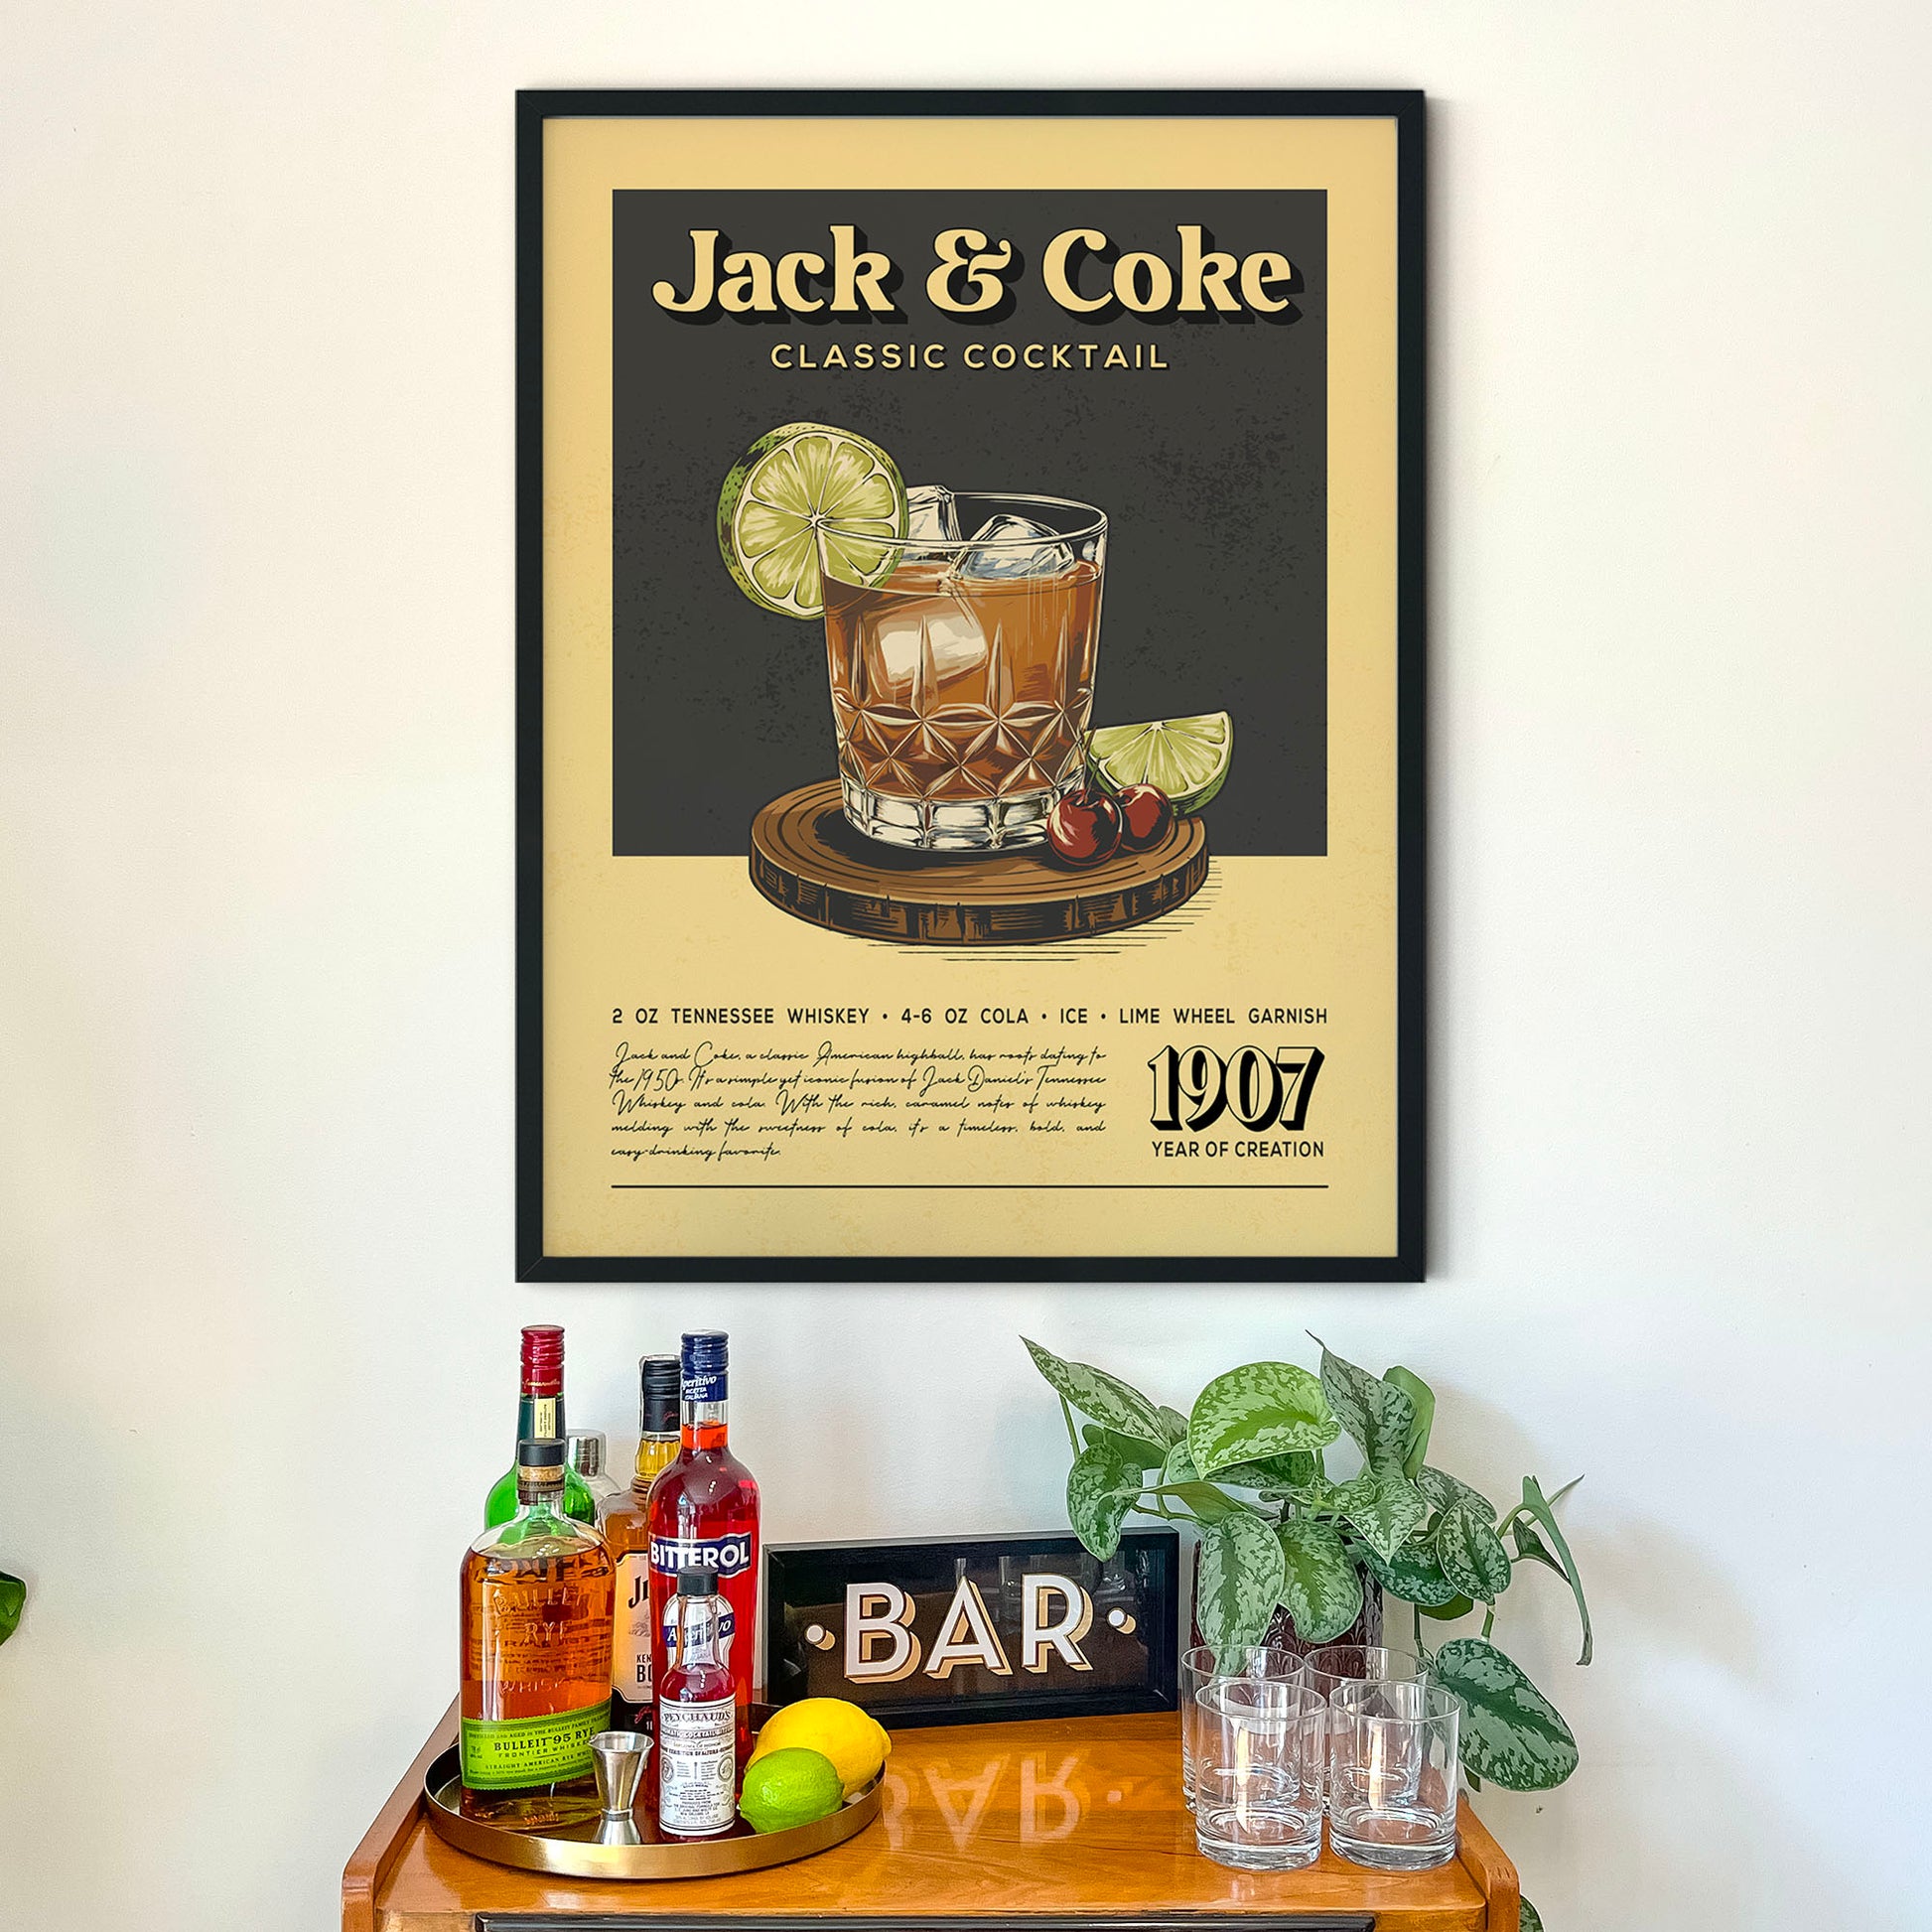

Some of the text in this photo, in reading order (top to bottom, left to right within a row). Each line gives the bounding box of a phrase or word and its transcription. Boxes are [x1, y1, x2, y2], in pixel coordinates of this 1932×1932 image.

[652, 224, 1297, 318] Jack & Coke
[770, 344, 1170, 371] CLASSIC COCKTAIL
[612, 1008, 1328, 1024] 2 OZ TENNESSEE WHISKEY 4-6 OZ COLA ICE LIME WHEEL GARNISH
[613, 1040, 1107, 1072] Jack and Coke, a classic American highball, has roots dating to
[609, 1069, 634, 1089] the
[716, 1075, 729, 1084] a
[727, 1072, 778, 1089] simple
[778, 1070, 803, 1089] yet
[803, 1072, 849, 1084] iconic
[847, 1068, 899, 1089] fusion
[899, 1068, 916, 1089] of
[918, 1065, 965, 1097] Jack
[967, 1064, 1034, 1092] Daniel's
[1035, 1064, 1107, 1091] Tennessee
[1147, 1044, 1326, 1133] 1907
[612, 1089, 687, 1115] Whiskey
[693, 1096, 724, 1108] and
[775, 1089, 823, 1115] With
[828, 1093, 854, 1113] the
[861, 1096, 897, 1109] rich,
[904, 1096, 970, 1109] caramel
[977, 1094, 1016, 1113] notes
[1022, 1093, 1039, 1114] of
[1045, 1096, 1106, 1114] whiskey
[612, 1120, 673, 1138] melding
[683, 1118, 718, 1137] with
[724, 1118, 751, 1137] the
[758, 1118, 826, 1137] sweetness
[836, 1116, 852, 1138] of
[862, 1120, 897, 1133] cola,
[957, 1118, 1019, 1138] timeless,
[1030, 1120, 1065, 1133] bold,
[1075, 1120, 1107, 1132] and
[611, 1141, 781, 1162] easy-drinking favorite.
[1152, 1141, 1325, 1158] YEAR OF CREATION
[650, 1542, 750, 1570] BITTEROL
[844, 1572, 1093, 1683] BAR
[636, 1654, 652, 1664] KEN
[494, 1726, 596, 1751] BULLEIT 95 RYE
[498, 1739, 591, 1758] FRONTIER WHISKE
